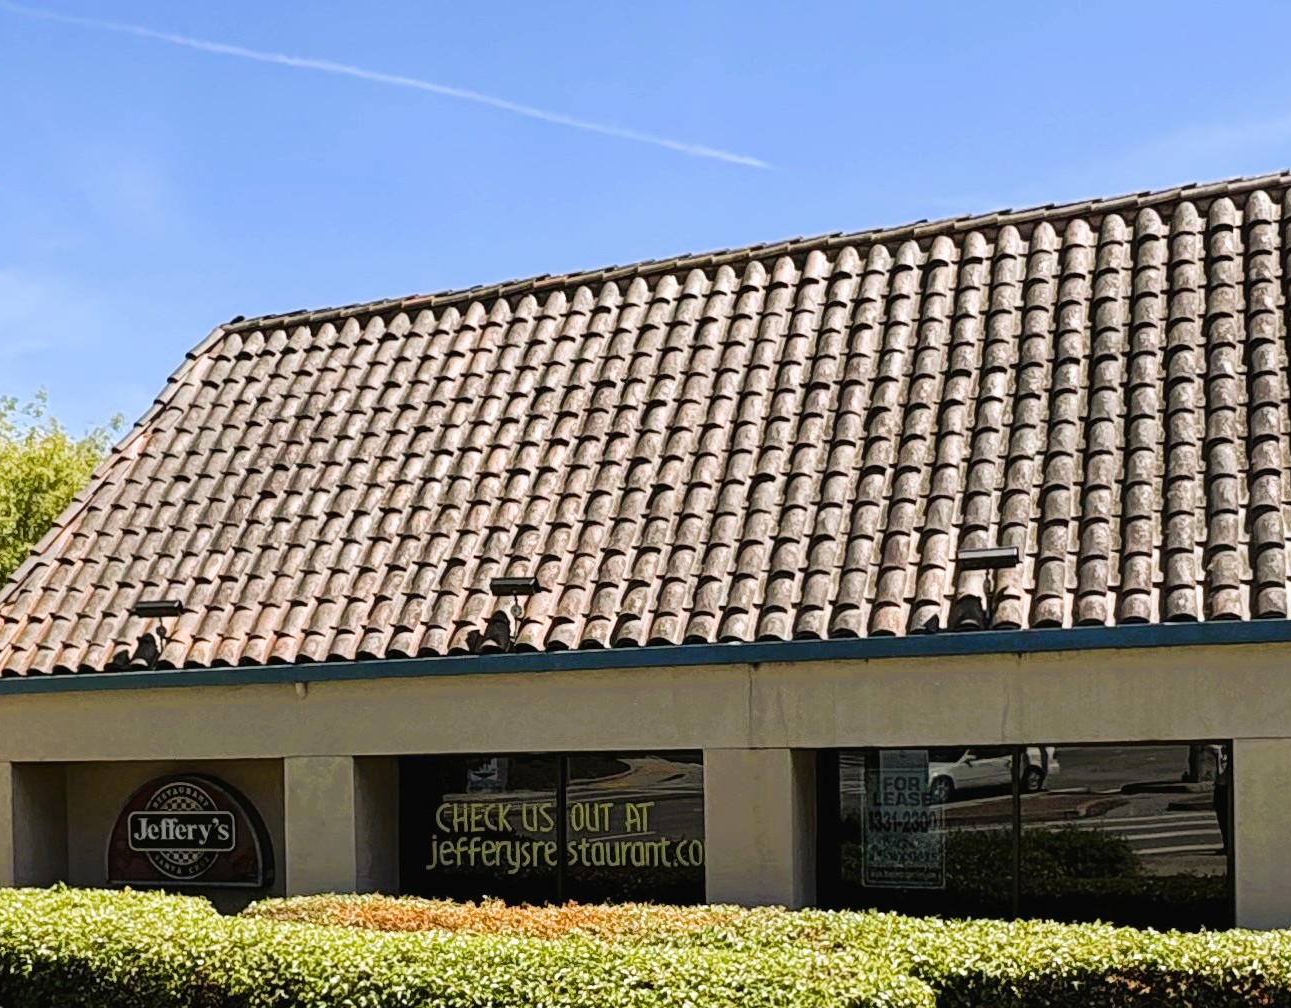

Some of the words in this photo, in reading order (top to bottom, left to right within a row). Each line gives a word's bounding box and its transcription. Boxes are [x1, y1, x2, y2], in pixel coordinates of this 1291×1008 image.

[883, 776, 921, 792] FOR
[152, 786, 209, 808] RESTAURANT
[873, 791, 932, 807] LEASE
[435, 801, 513, 833] CHECK
[522, 801, 555, 833] US
[570, 801, 613, 833] OUT
[625, 800, 656, 834] AT
[133, 817, 230, 846] Jeffery's
